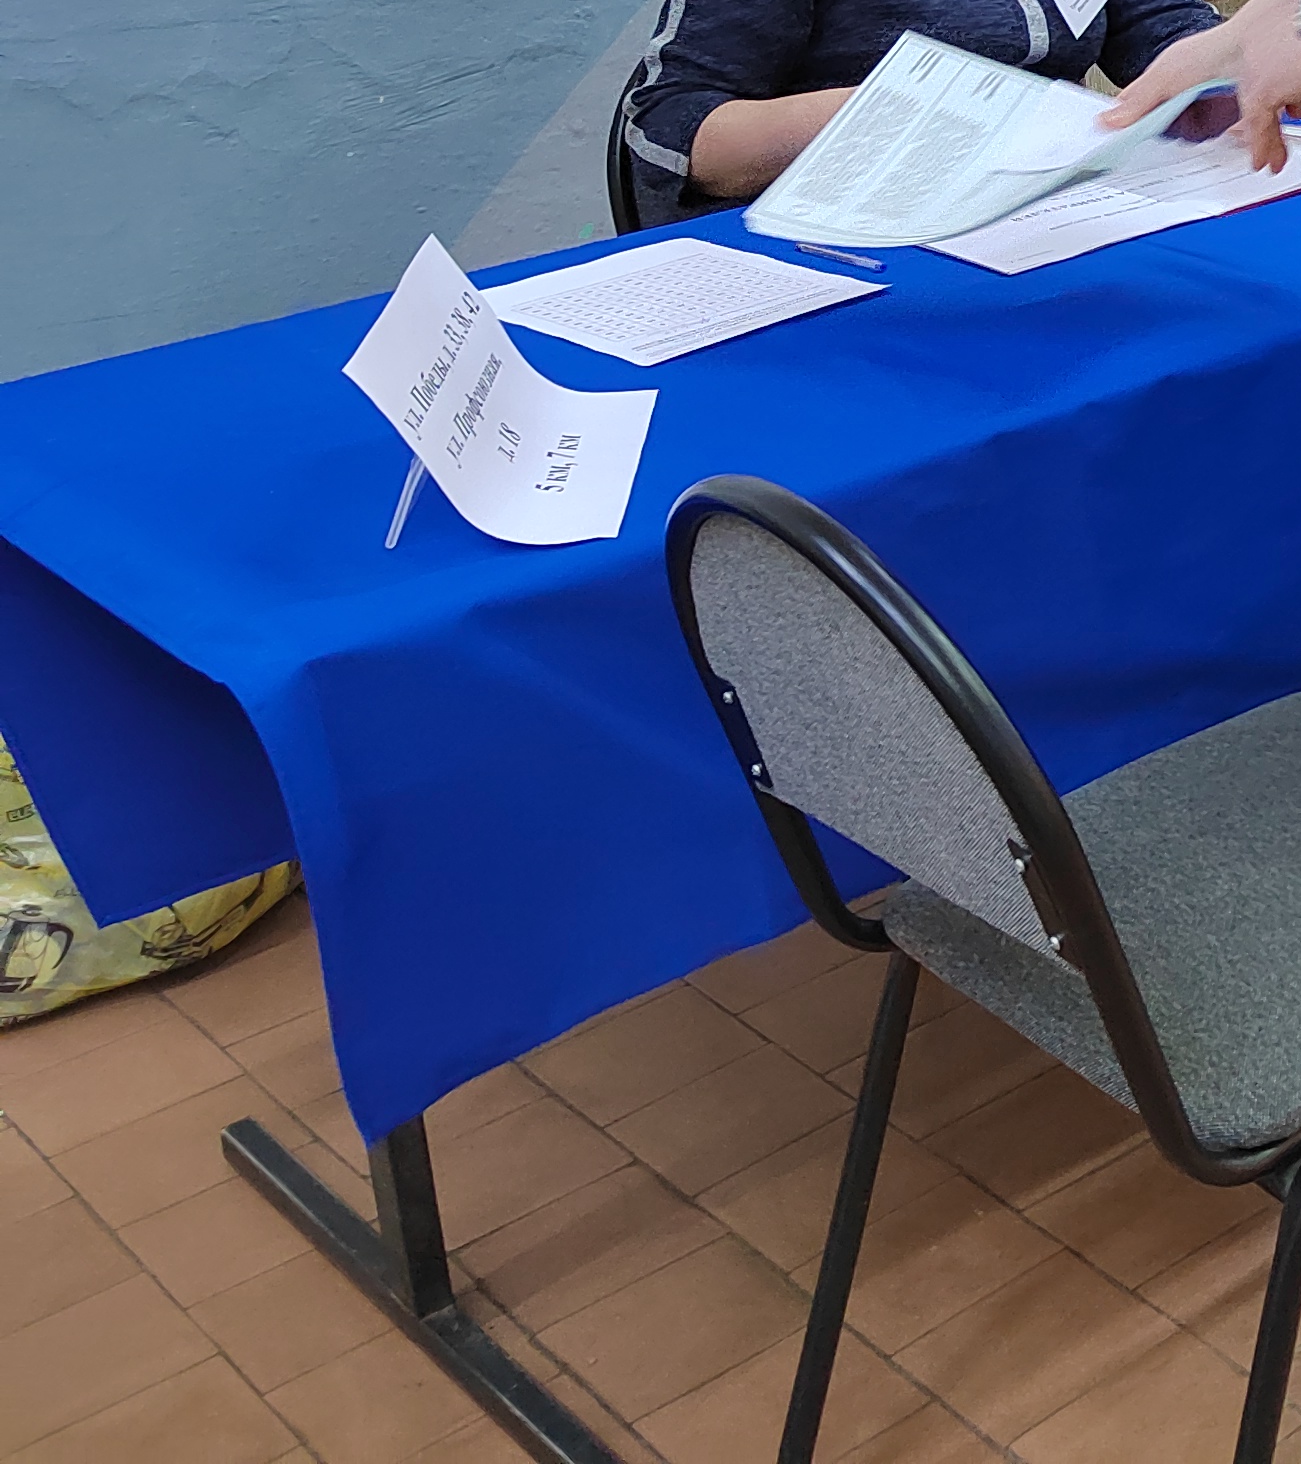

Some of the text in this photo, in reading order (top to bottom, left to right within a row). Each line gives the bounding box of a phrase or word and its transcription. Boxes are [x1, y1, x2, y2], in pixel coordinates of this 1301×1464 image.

[462, 291, 480, 315] 42
[451, 307, 476, 335] 38,
[410, 357, 454, 413] Победы,
[404, 408, 424, 441] ул.
[446, 352, 503, 469] ул. Профсоюзная,
[498, 422, 521, 464] д. 18
[557, 435, 582, 450] км
[546, 463, 578, 482] км,
[535, 484, 564, 492] 5
